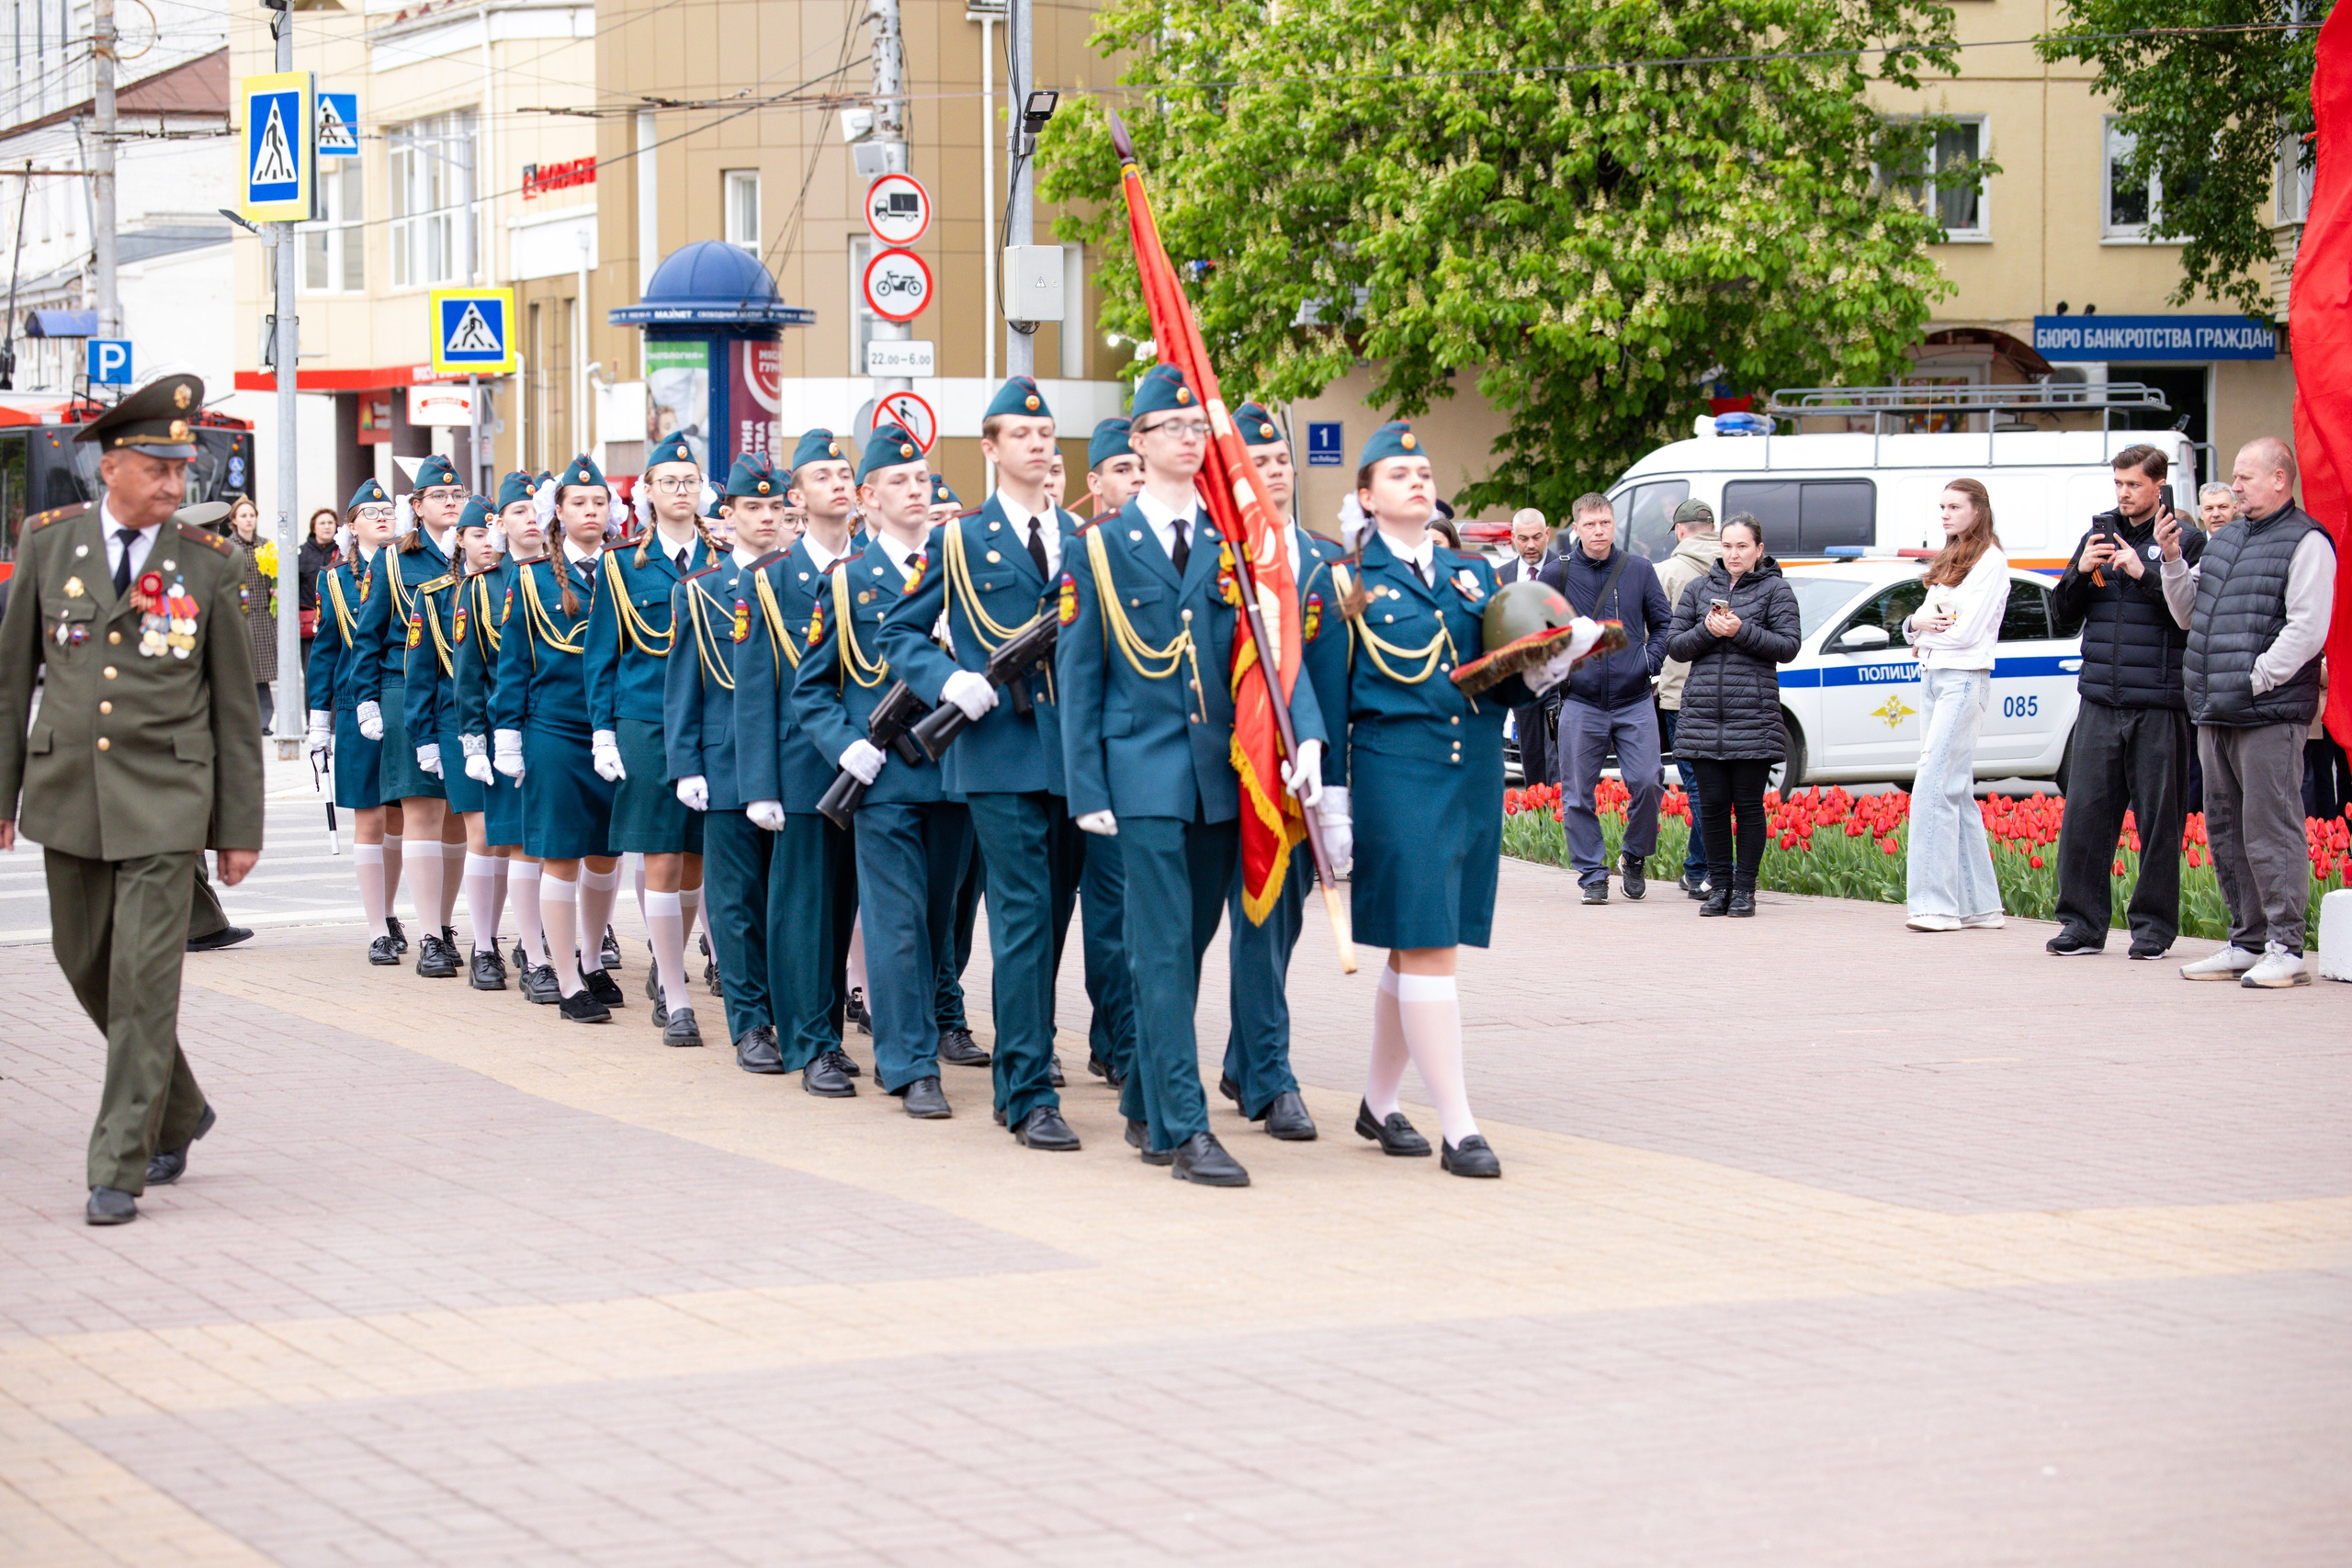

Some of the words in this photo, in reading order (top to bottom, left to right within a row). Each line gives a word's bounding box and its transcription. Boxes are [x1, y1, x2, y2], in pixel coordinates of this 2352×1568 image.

[2037, 328, 2081, 349] БЮРО
[2084, 328, 2193, 349] БАНКРОТСТВА
[2196, 327, 2274, 350] ГРАЖДАН
[99, 343, 126, 381] P
[1319, 427, 1329, 447] 1
[1858, 664, 1921, 682] ПОЛИЦИ
[2004, 695, 2038, 718] 085
